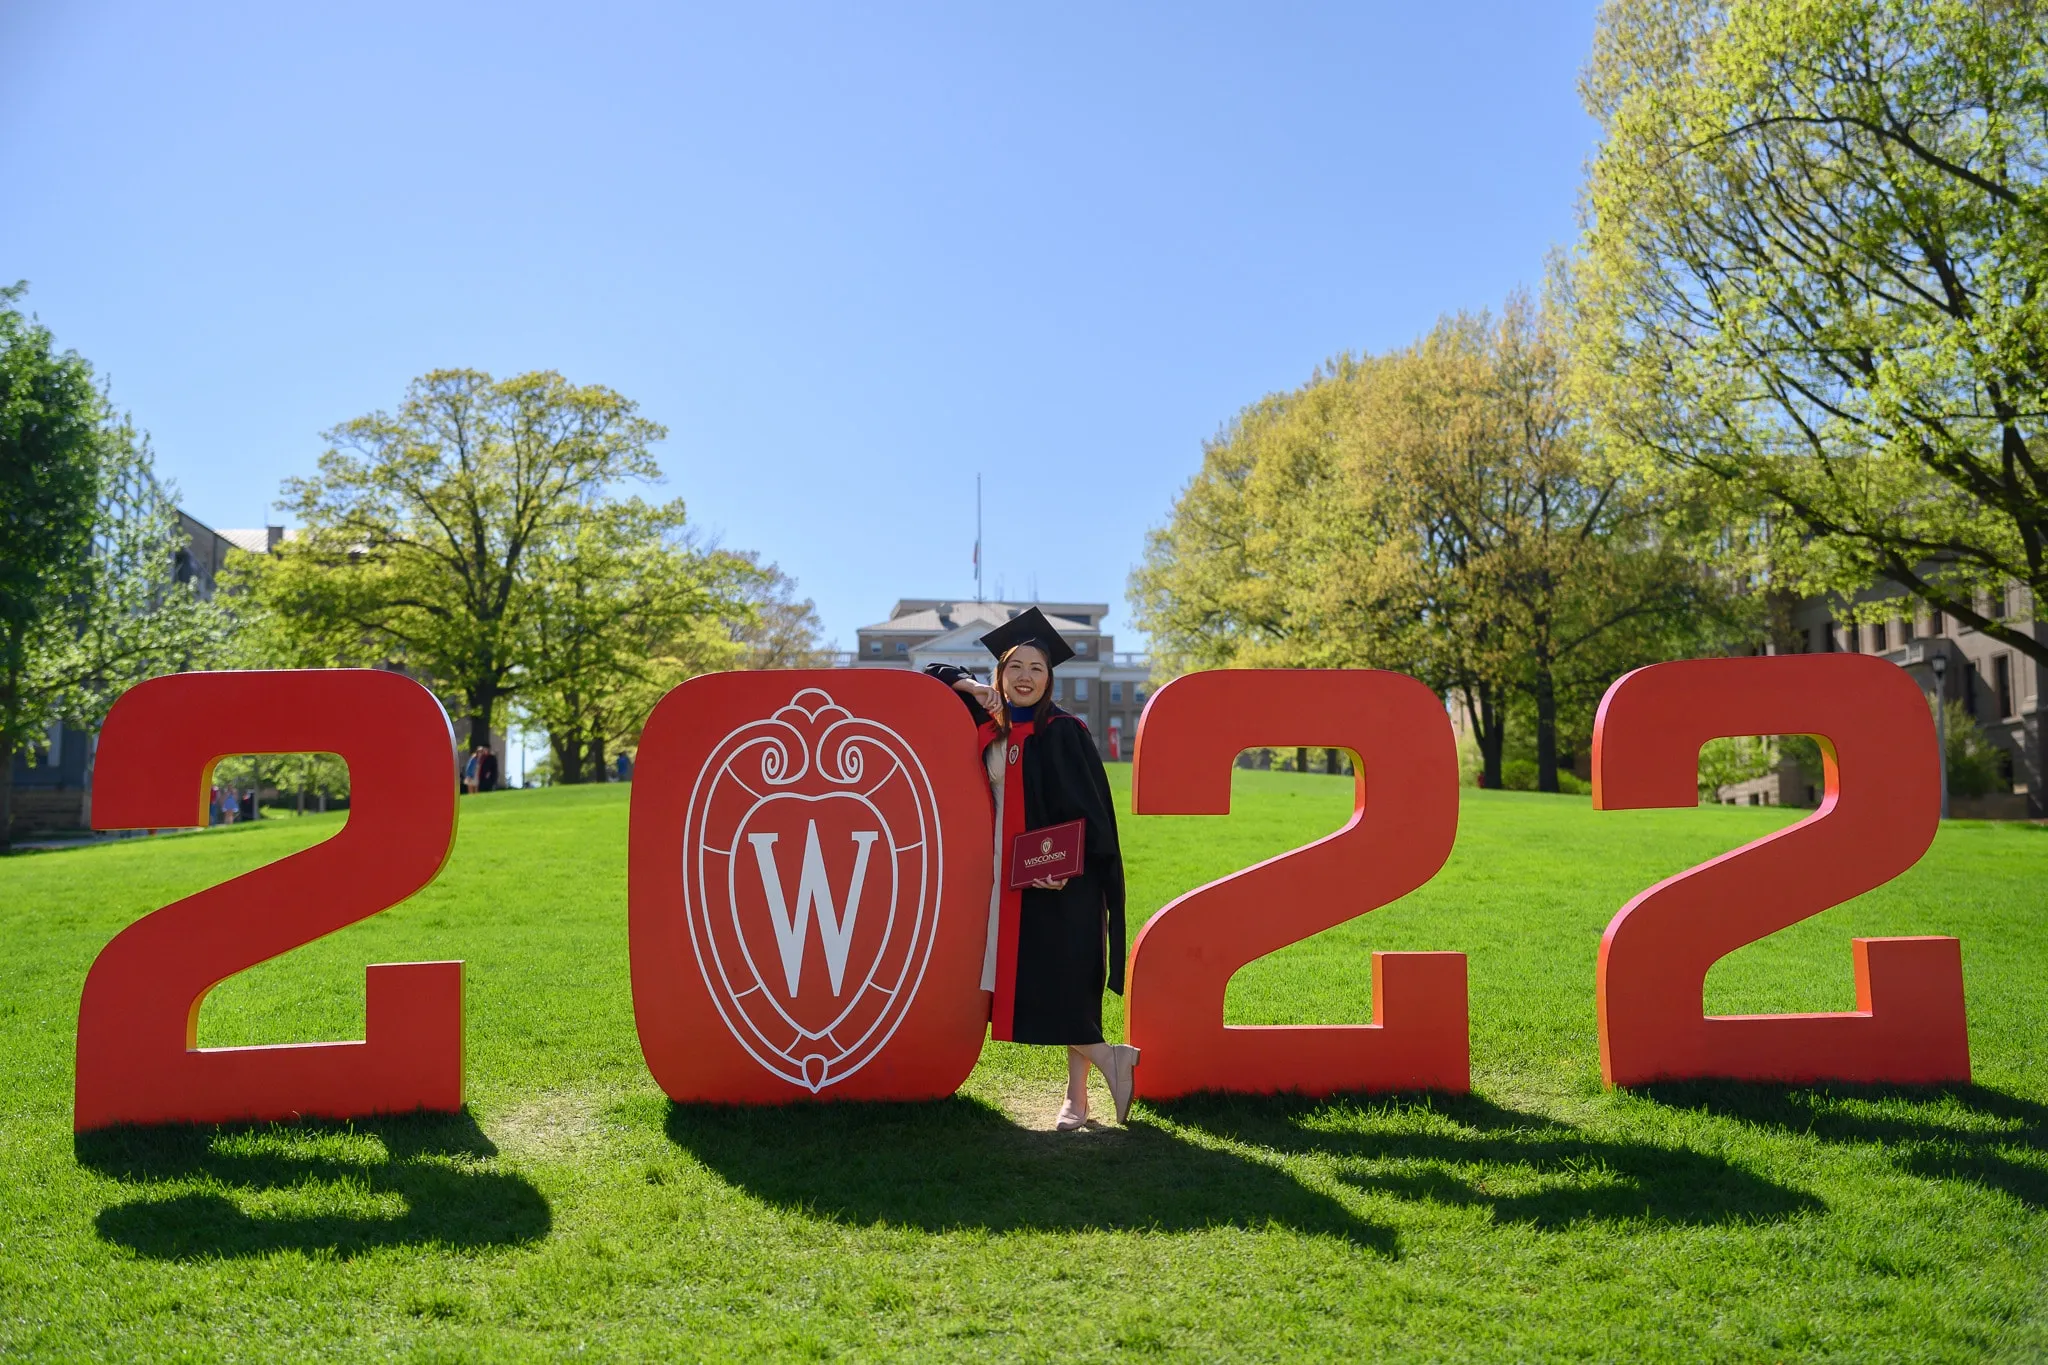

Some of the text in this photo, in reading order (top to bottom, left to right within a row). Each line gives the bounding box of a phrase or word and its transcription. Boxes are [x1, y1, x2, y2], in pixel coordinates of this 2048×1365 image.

[75, 652, 1971, 1132] 2022
[748, 819, 878, 998] W
[1024, 850, 1066, 866] WISCONSIN
